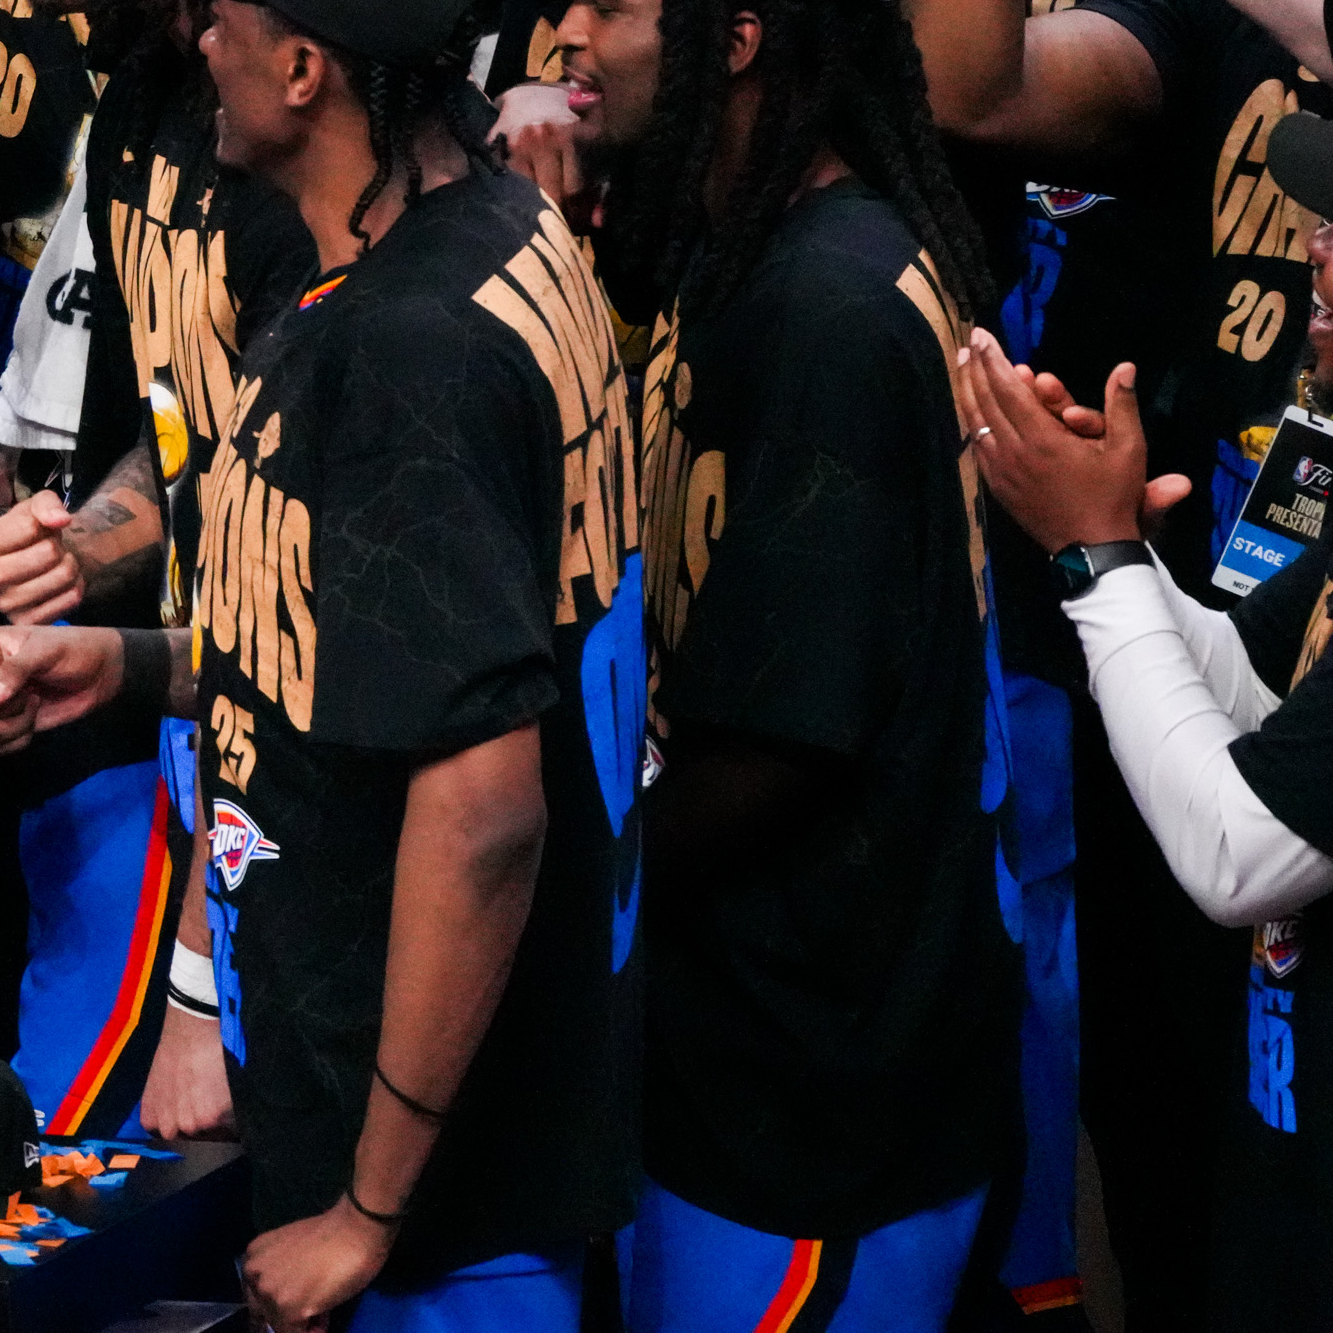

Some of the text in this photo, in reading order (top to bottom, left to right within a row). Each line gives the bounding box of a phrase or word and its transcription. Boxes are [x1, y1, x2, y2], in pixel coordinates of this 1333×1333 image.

[1218, 280, 1286, 362] 20
[1233, 537, 1286, 568] STAGE
[211, 694, 257, 795] 25
